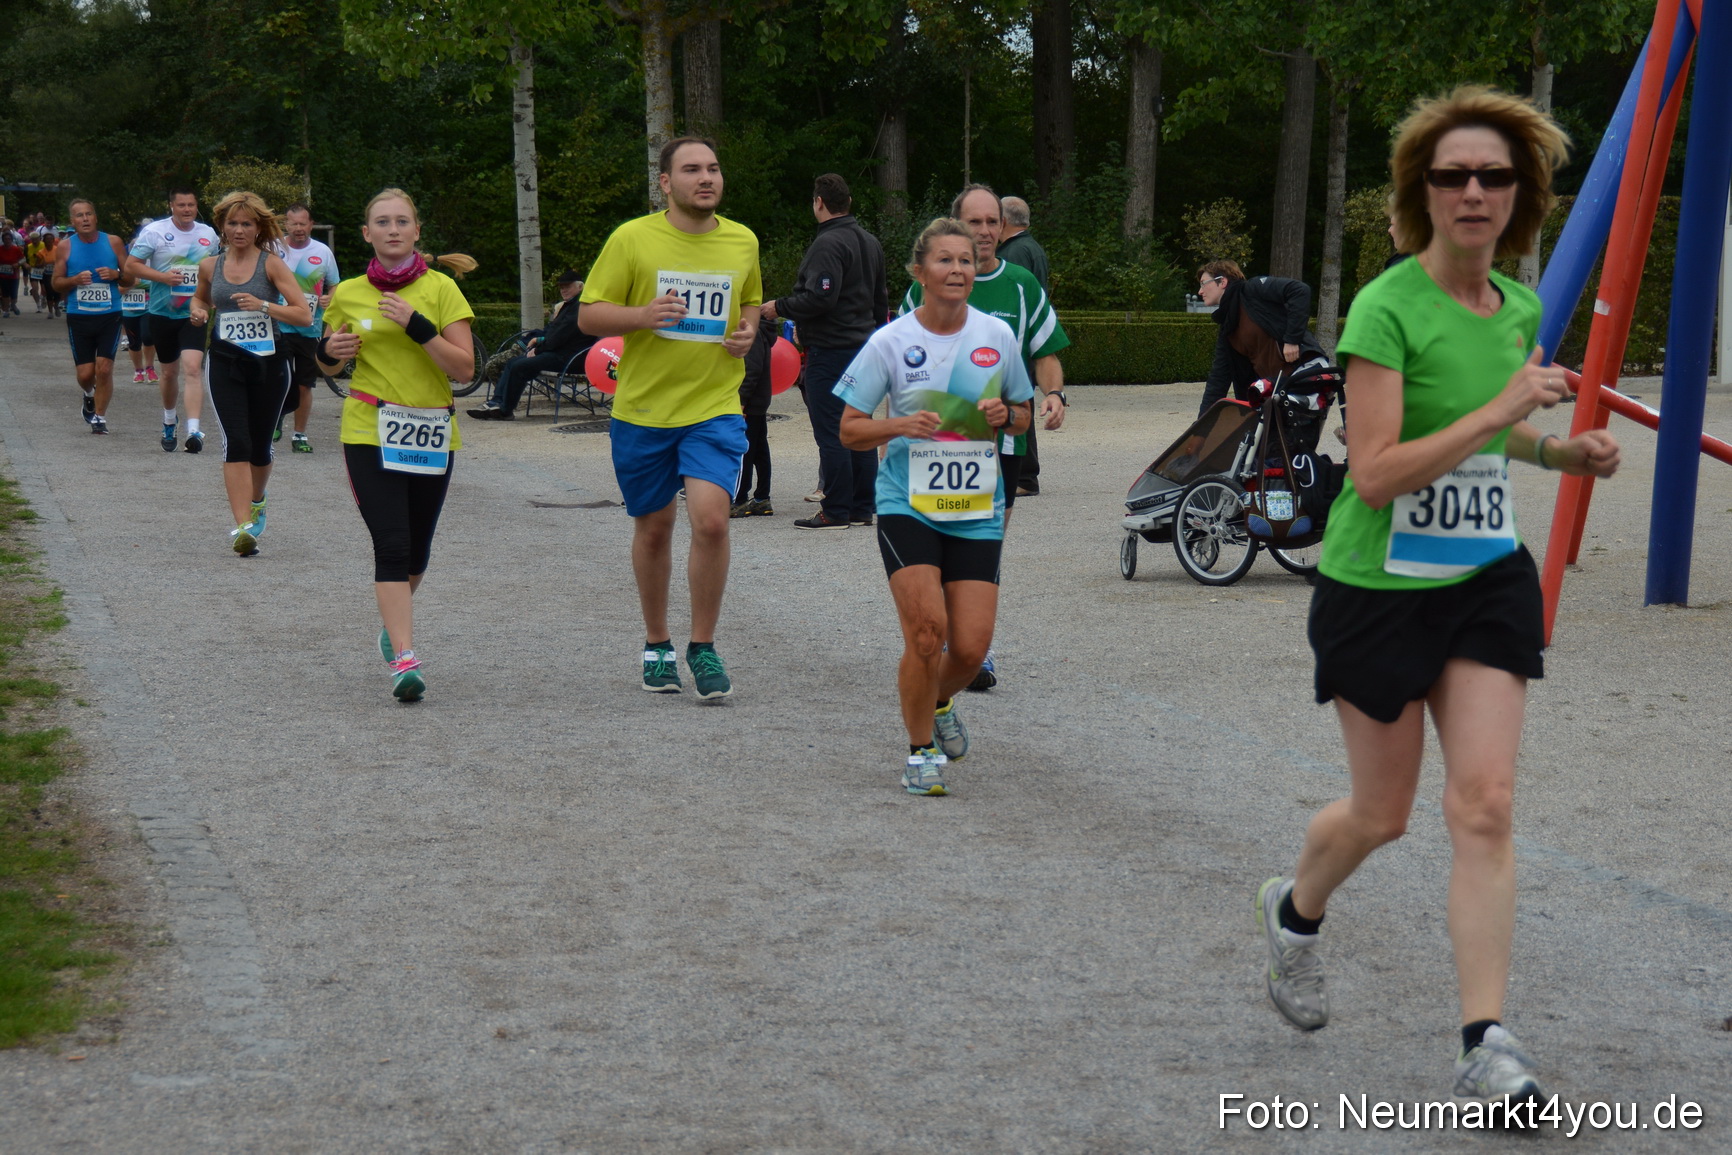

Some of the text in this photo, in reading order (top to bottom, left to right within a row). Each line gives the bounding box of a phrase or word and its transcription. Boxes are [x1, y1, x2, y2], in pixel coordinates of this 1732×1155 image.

[659, 277, 720, 289] PARTL Neumarkt
[81, 290, 109, 301] 2289
[225, 321, 269, 341] 2333
[677, 320, 706, 333] Robin
[905, 370, 930, 379] PARTL
[381, 409, 442, 422] PARTL Neumarkt
[386, 420, 446, 449] 2265
[398, 451, 429, 464] Sandra
[911, 449, 982, 459] PARTL Neumarkt
[928, 461, 980, 491] 202
[1446, 467, 1499, 479] Neumarkt
[936, 498, 971, 510] Gisela
[1408, 484, 1504, 531] 3048
